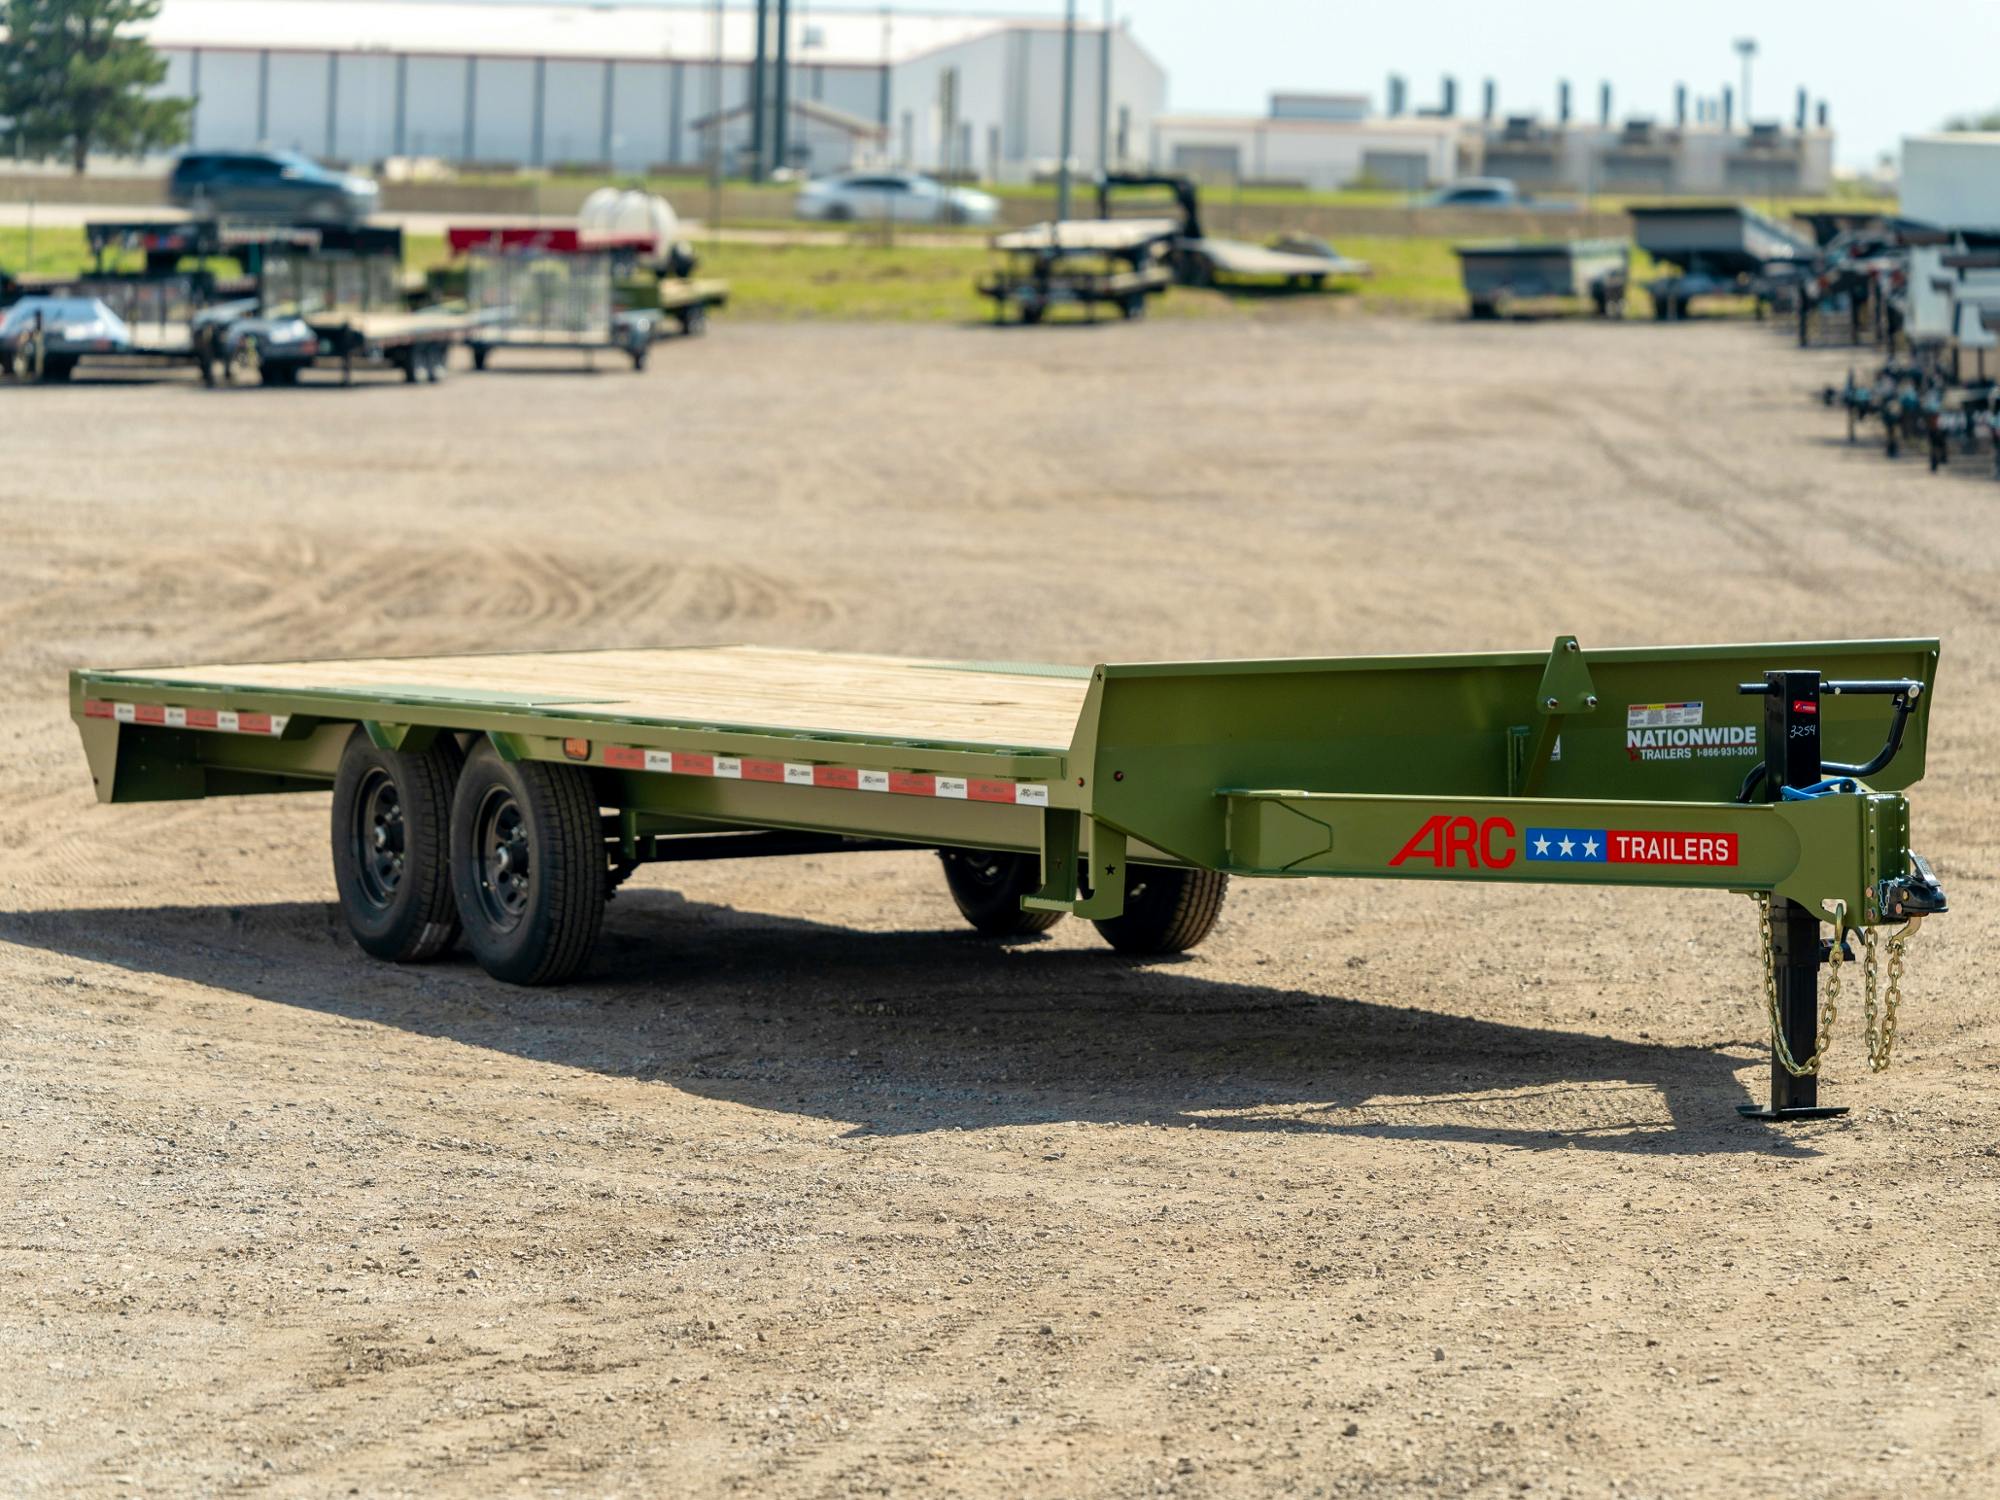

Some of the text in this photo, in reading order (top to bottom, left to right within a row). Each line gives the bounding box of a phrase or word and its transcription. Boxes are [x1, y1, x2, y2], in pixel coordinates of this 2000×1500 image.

[1627, 726, 1757, 748] NATIONWIDE
[1640, 746, 1757, 761] TRAILERS 1-866-931-3001
[1387, 815, 1729, 869] ARC TRAILERS
